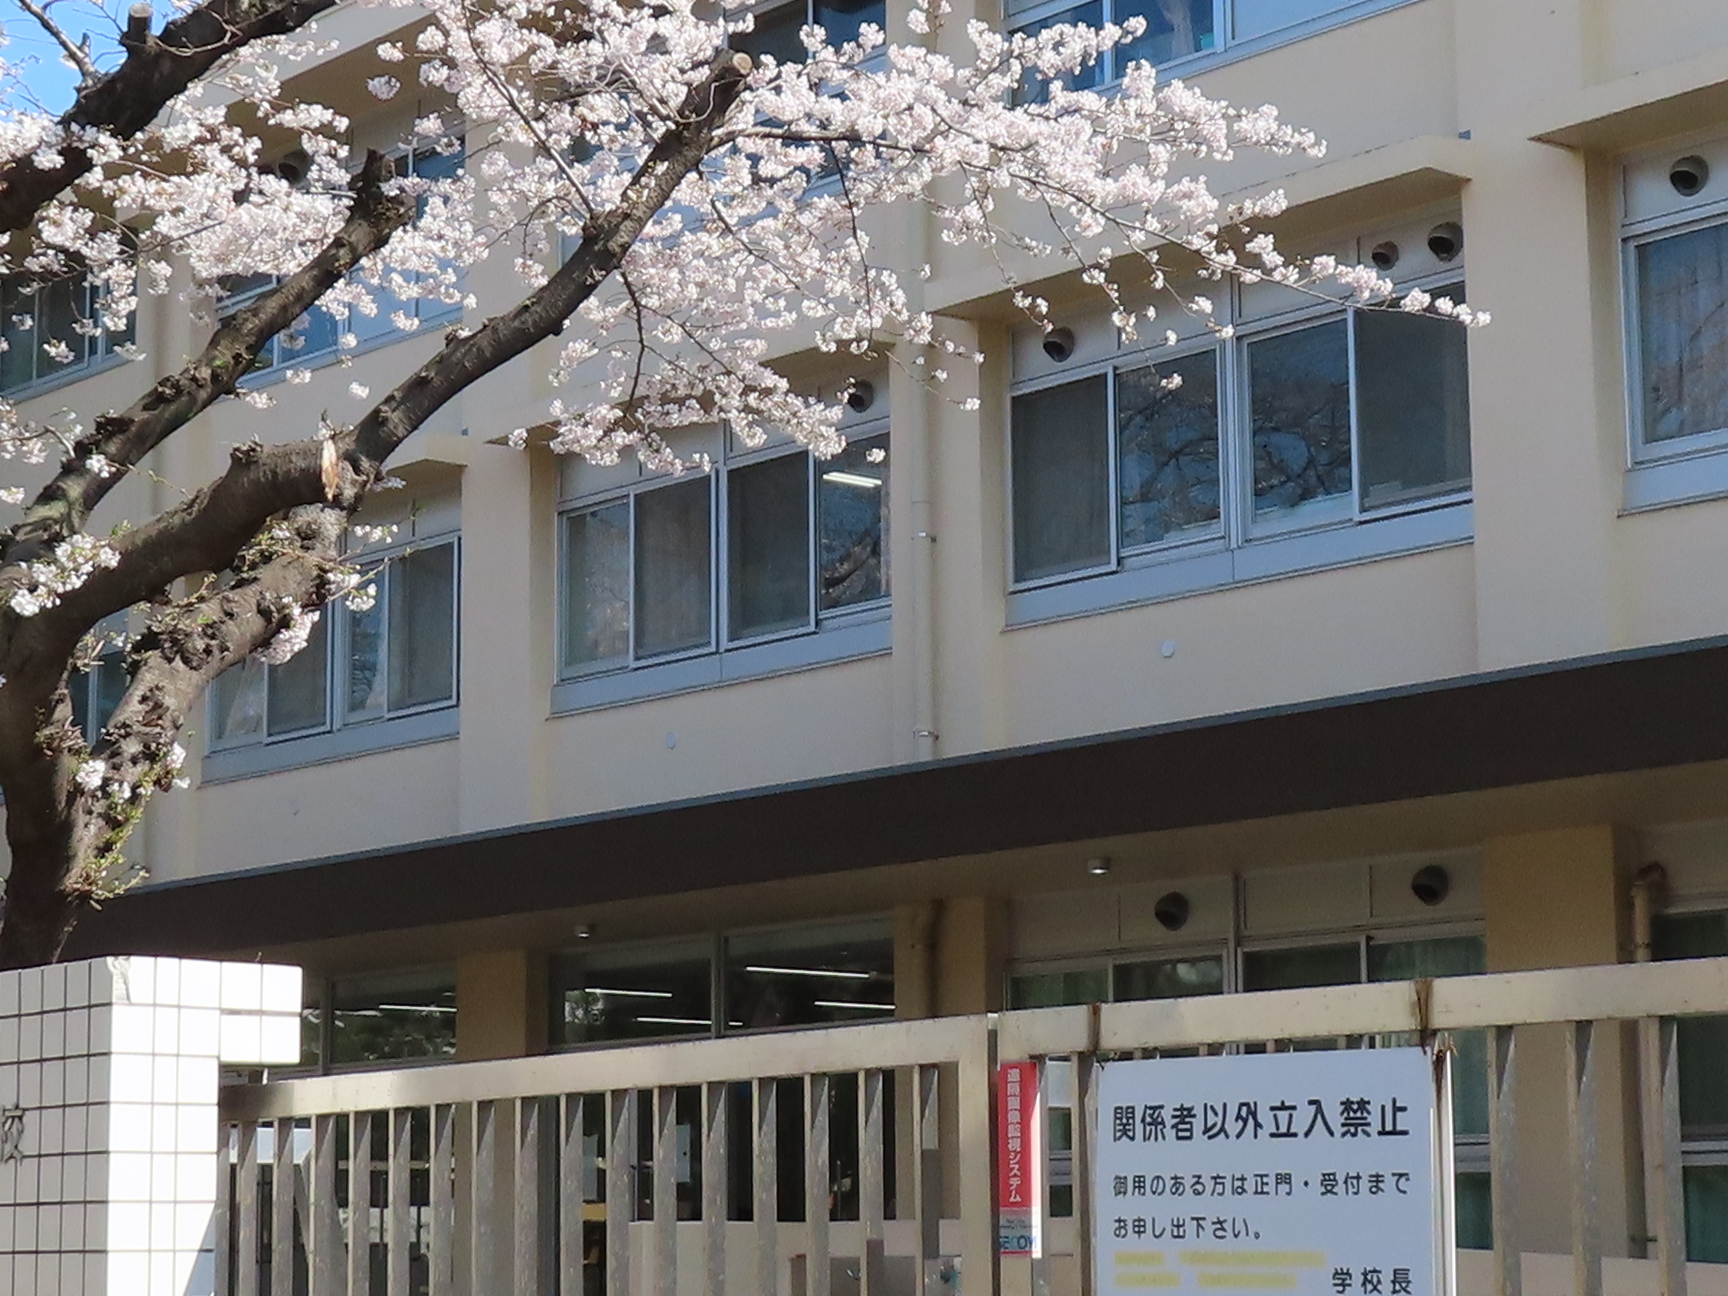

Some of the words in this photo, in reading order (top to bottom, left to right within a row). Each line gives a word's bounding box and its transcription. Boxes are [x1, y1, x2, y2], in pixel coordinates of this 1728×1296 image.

[1113, 1097, 1410, 1142] 関係者以外立入禁止
[1113, 1171, 1411, 1197] 御用のある方は正門・受付まで
[1113, 1216, 1261, 1240] お申し出下さい。
[1332, 1266, 1413, 1295] 学校長
